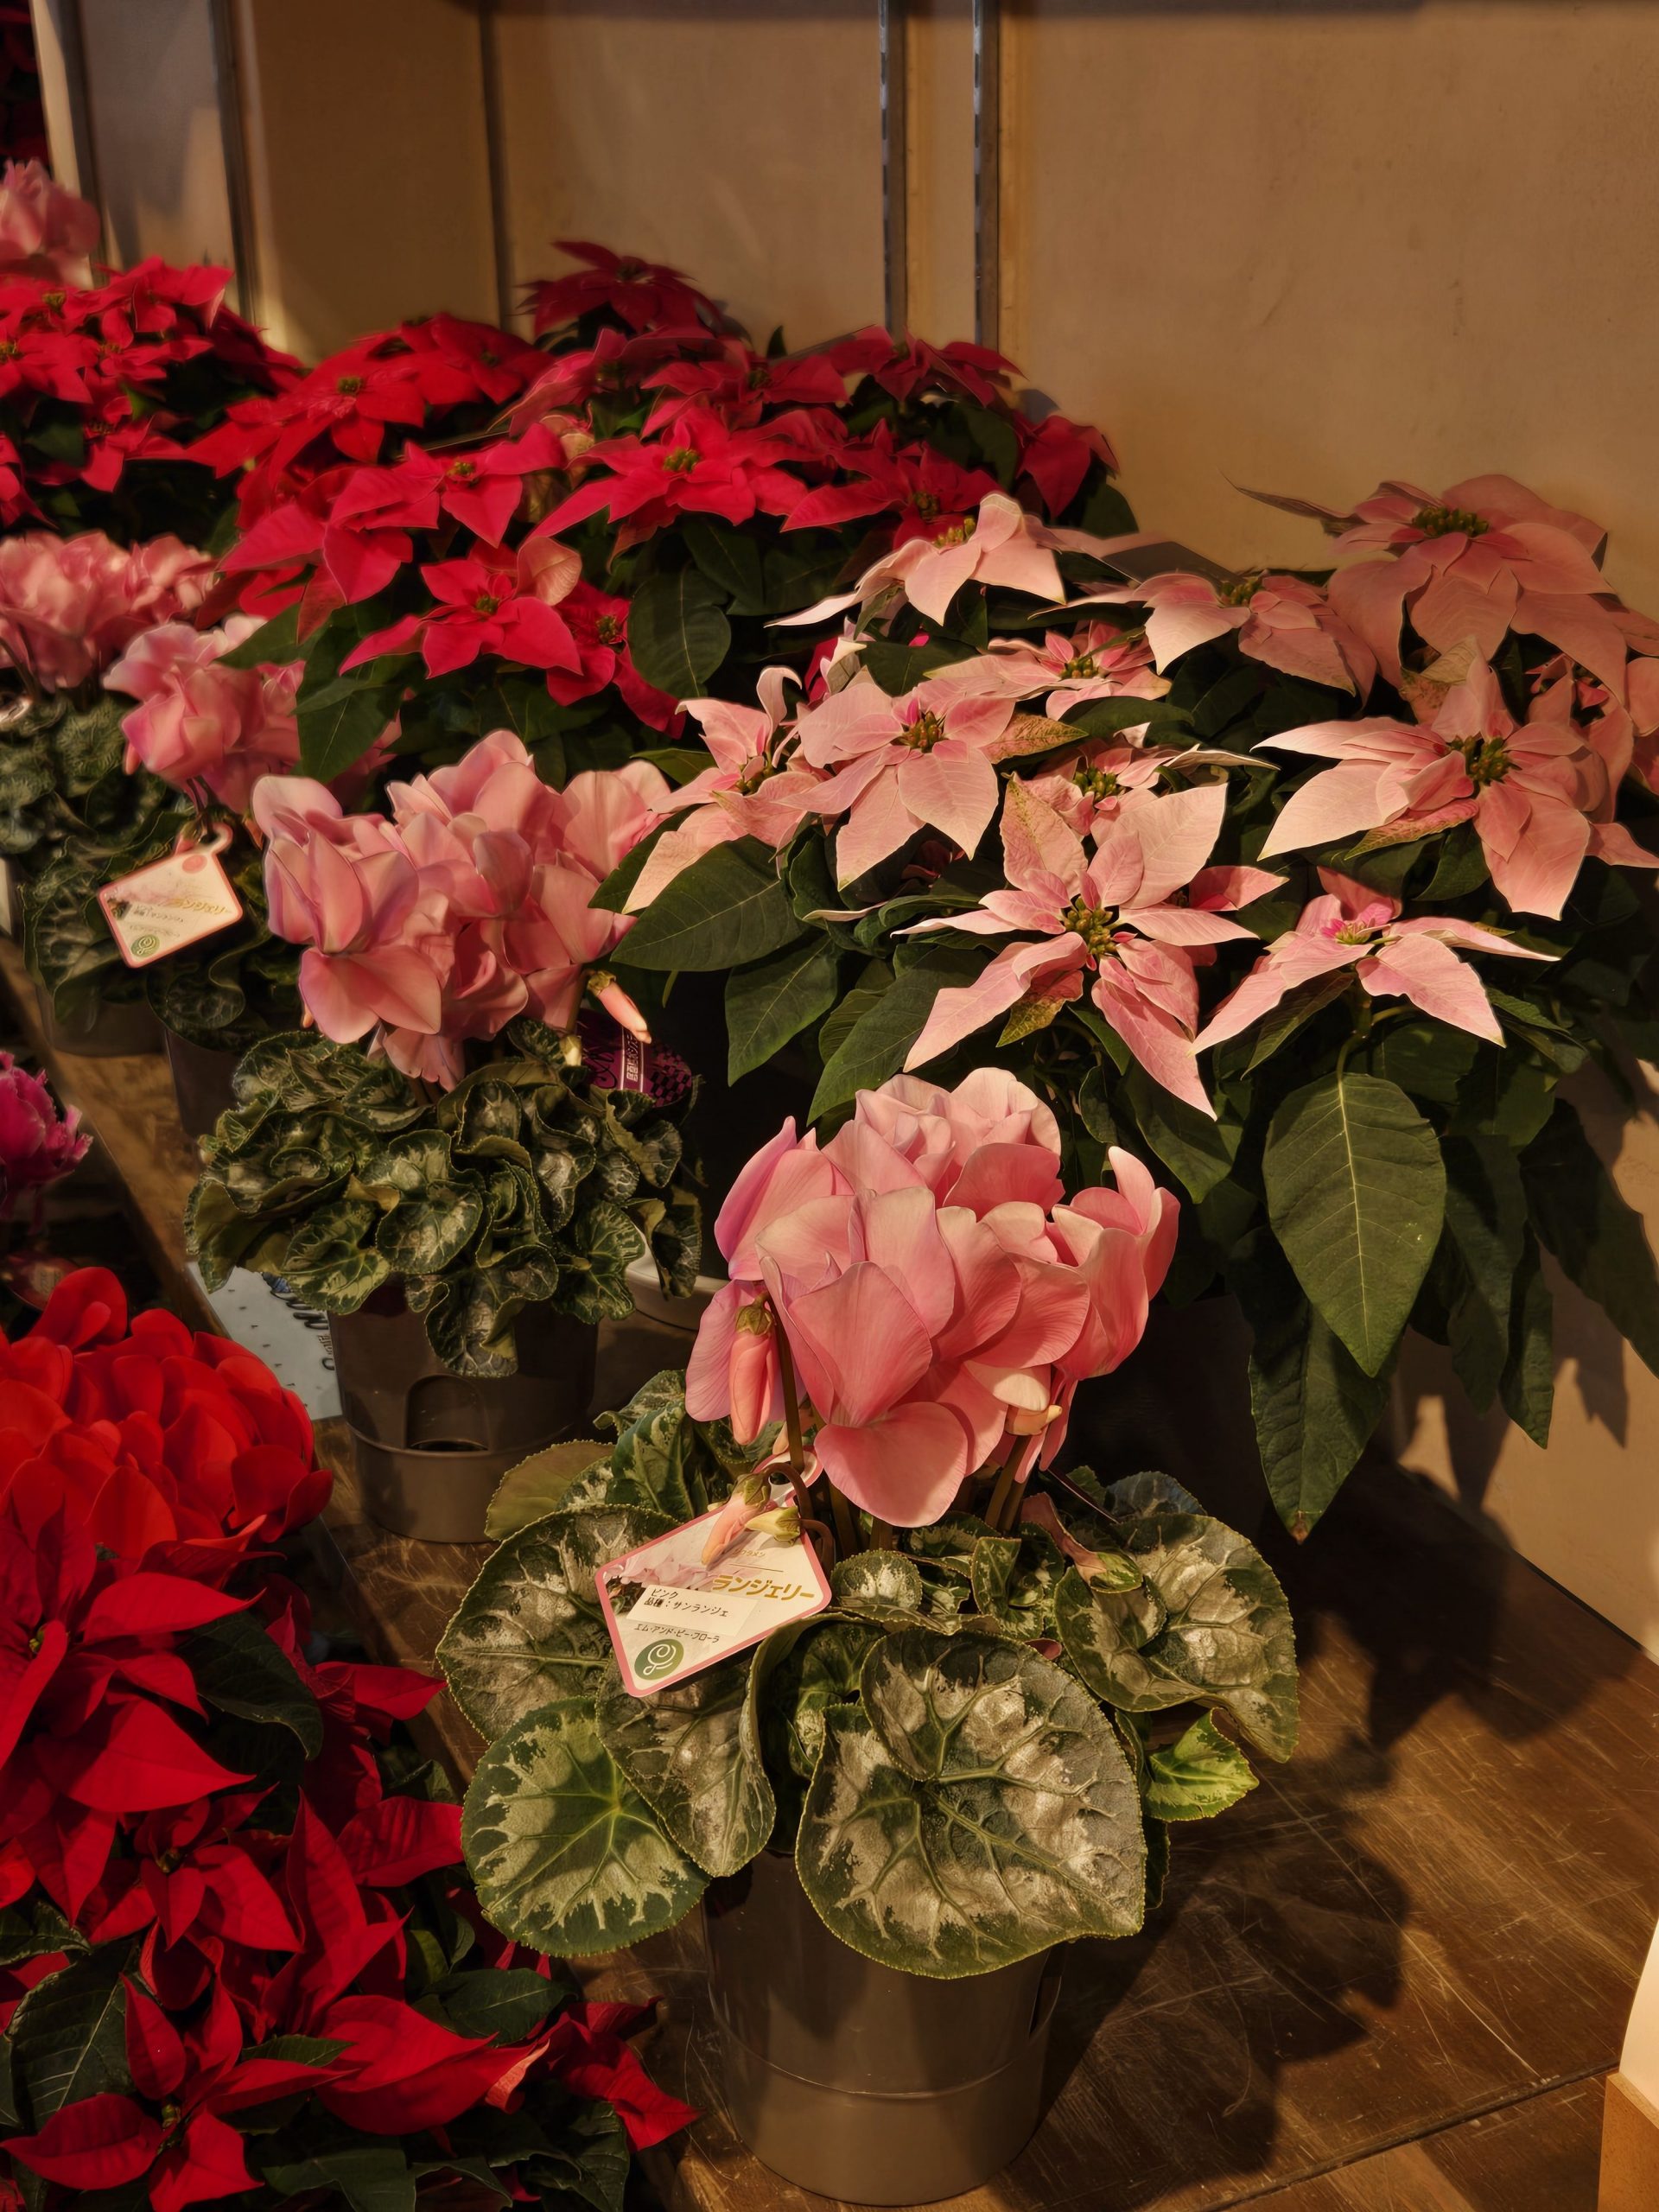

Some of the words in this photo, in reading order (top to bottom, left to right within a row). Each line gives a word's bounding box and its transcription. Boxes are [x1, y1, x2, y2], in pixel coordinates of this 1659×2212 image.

[651, 1588, 678, 1599] ピンク
[712, 1575, 815, 1601] ランジェリー
